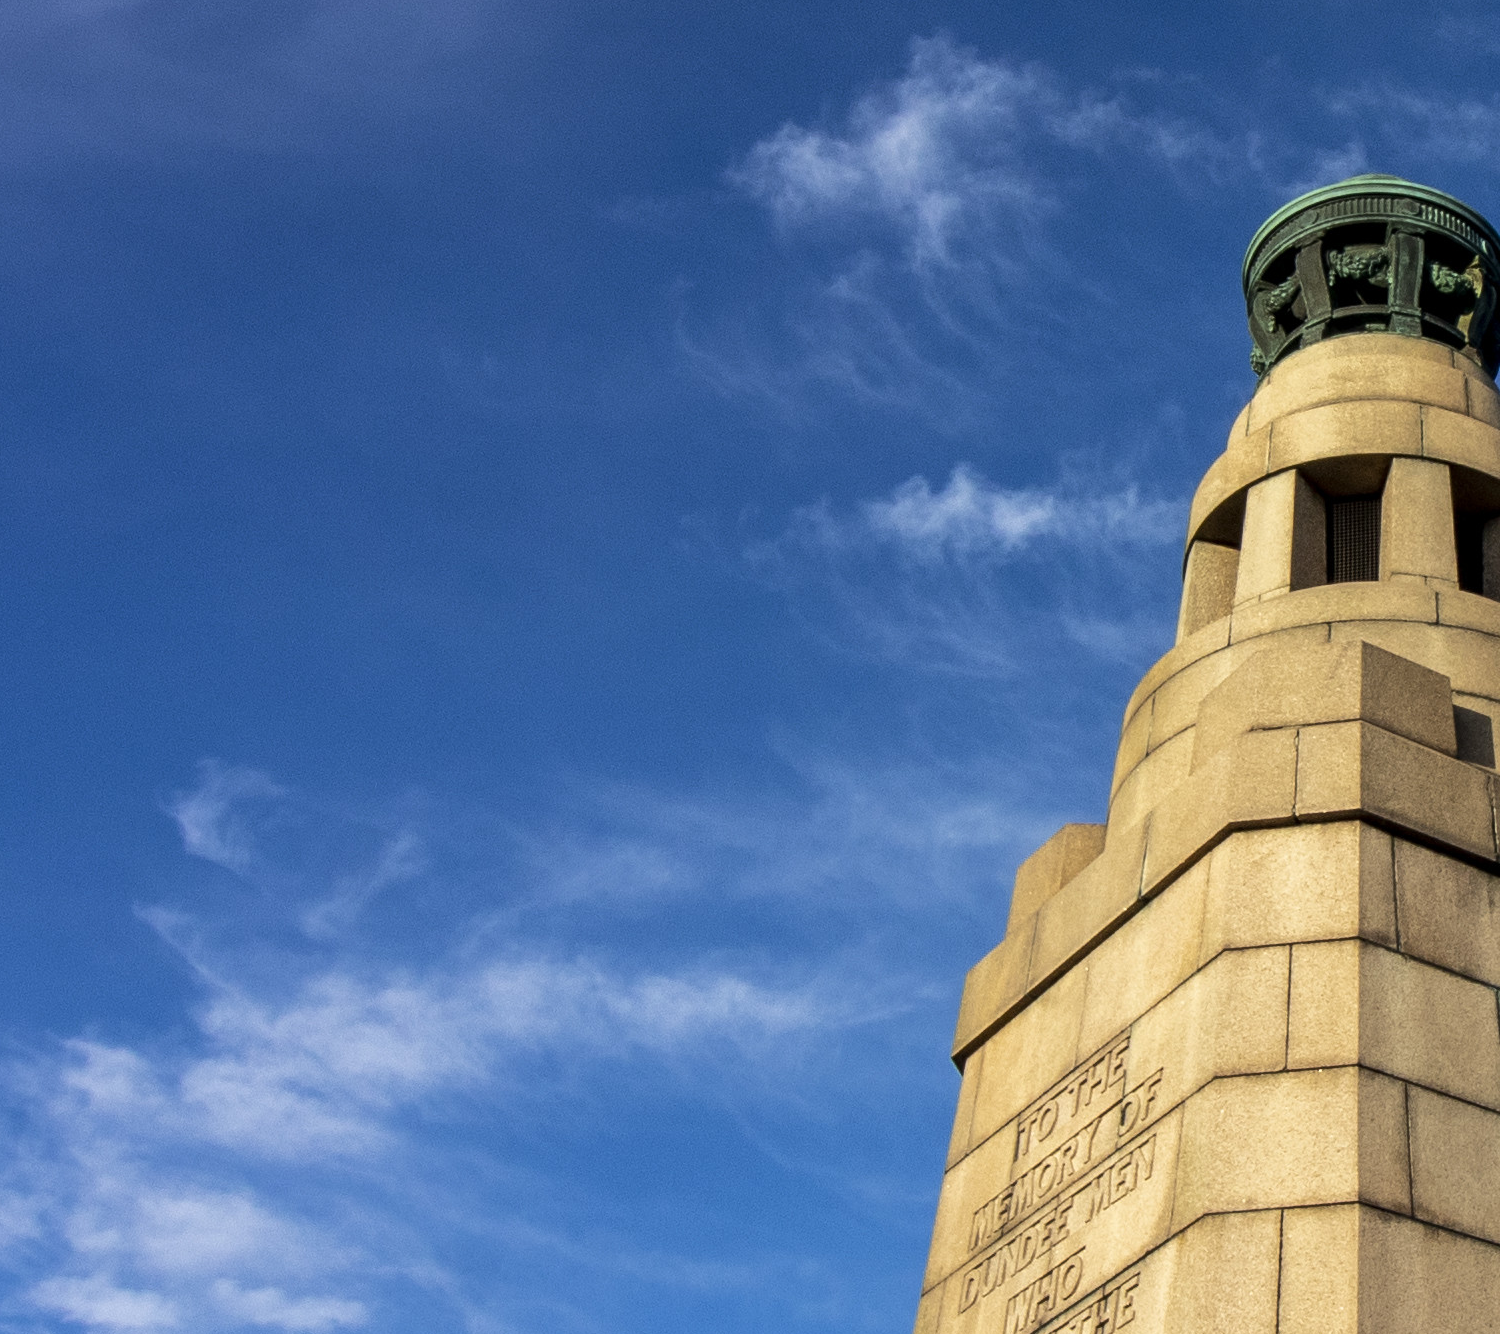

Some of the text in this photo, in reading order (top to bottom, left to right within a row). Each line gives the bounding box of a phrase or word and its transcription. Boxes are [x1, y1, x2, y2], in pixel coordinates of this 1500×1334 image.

[968, 1069, 1163, 1252] MEMORY OF
[1016, 1038, 1130, 1157] TO THE
[958, 1135, 1156, 1314] DUNDEE MEN
